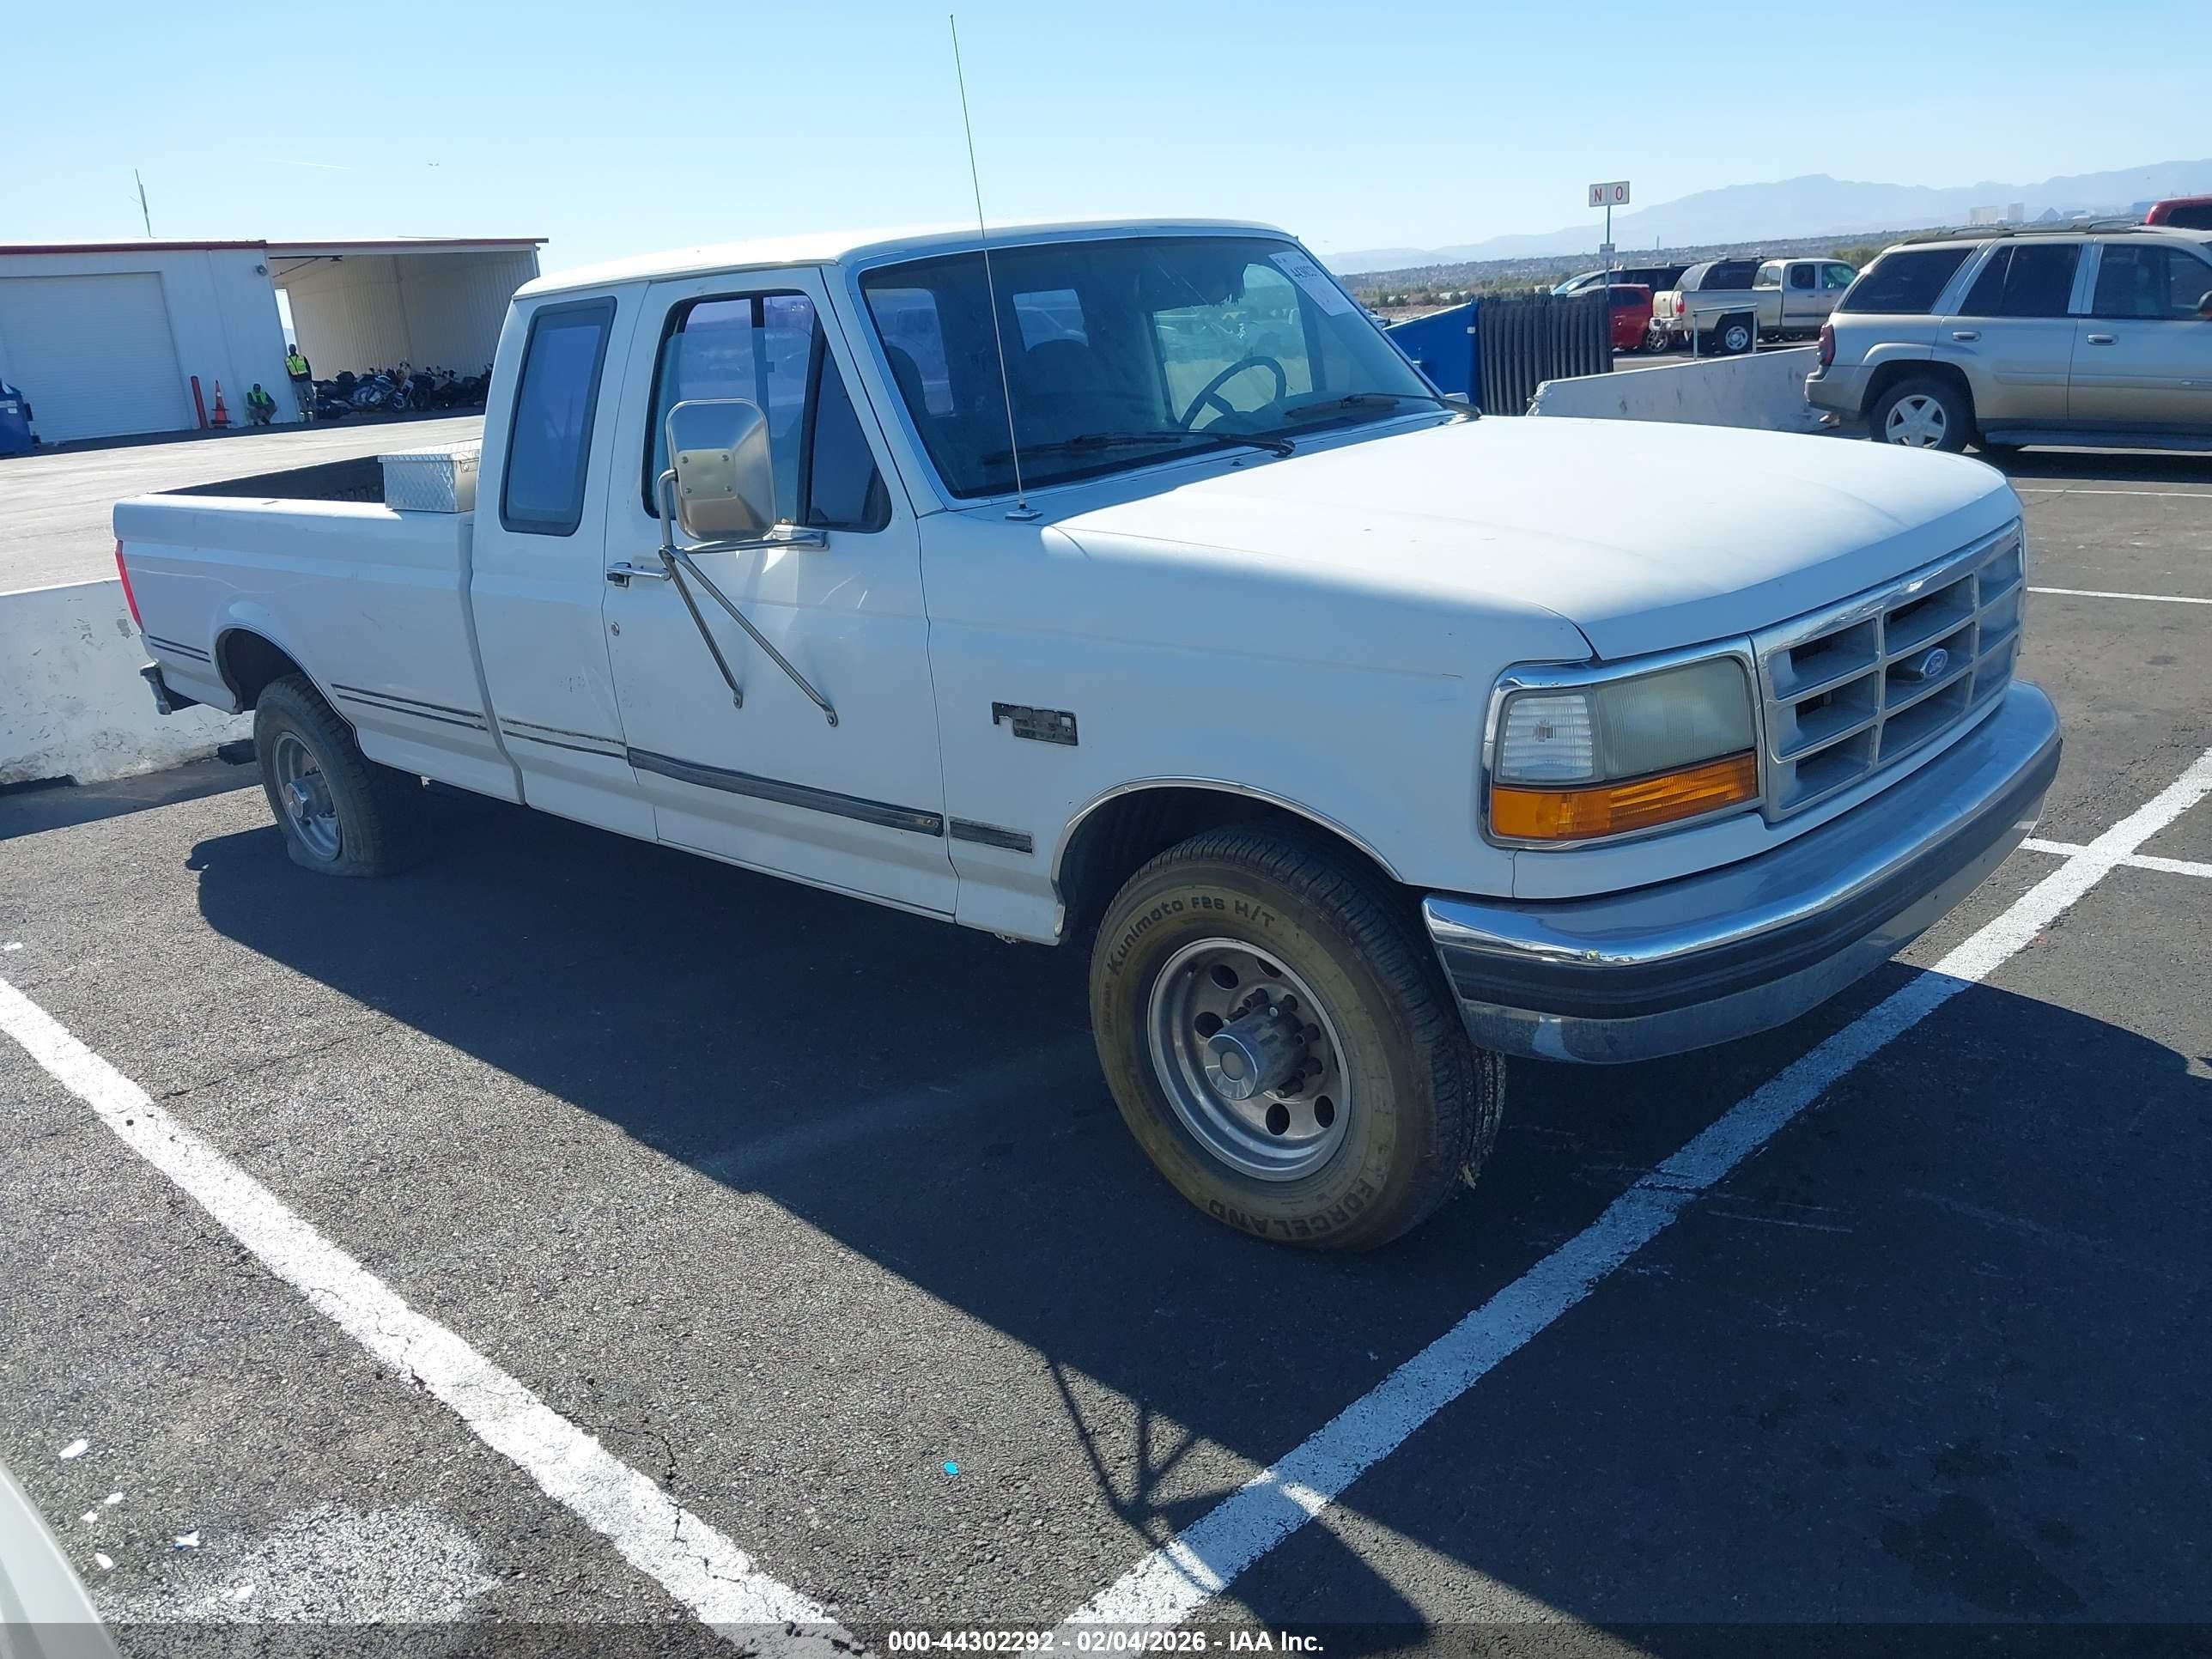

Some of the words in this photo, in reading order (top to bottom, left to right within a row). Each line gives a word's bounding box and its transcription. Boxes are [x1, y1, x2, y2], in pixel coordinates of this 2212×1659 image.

[1108, 899, 1184, 976] Kunimoto
[1235, 899, 1275, 928] H/T
[1207, 1177, 1375, 1238] FORCELAND
